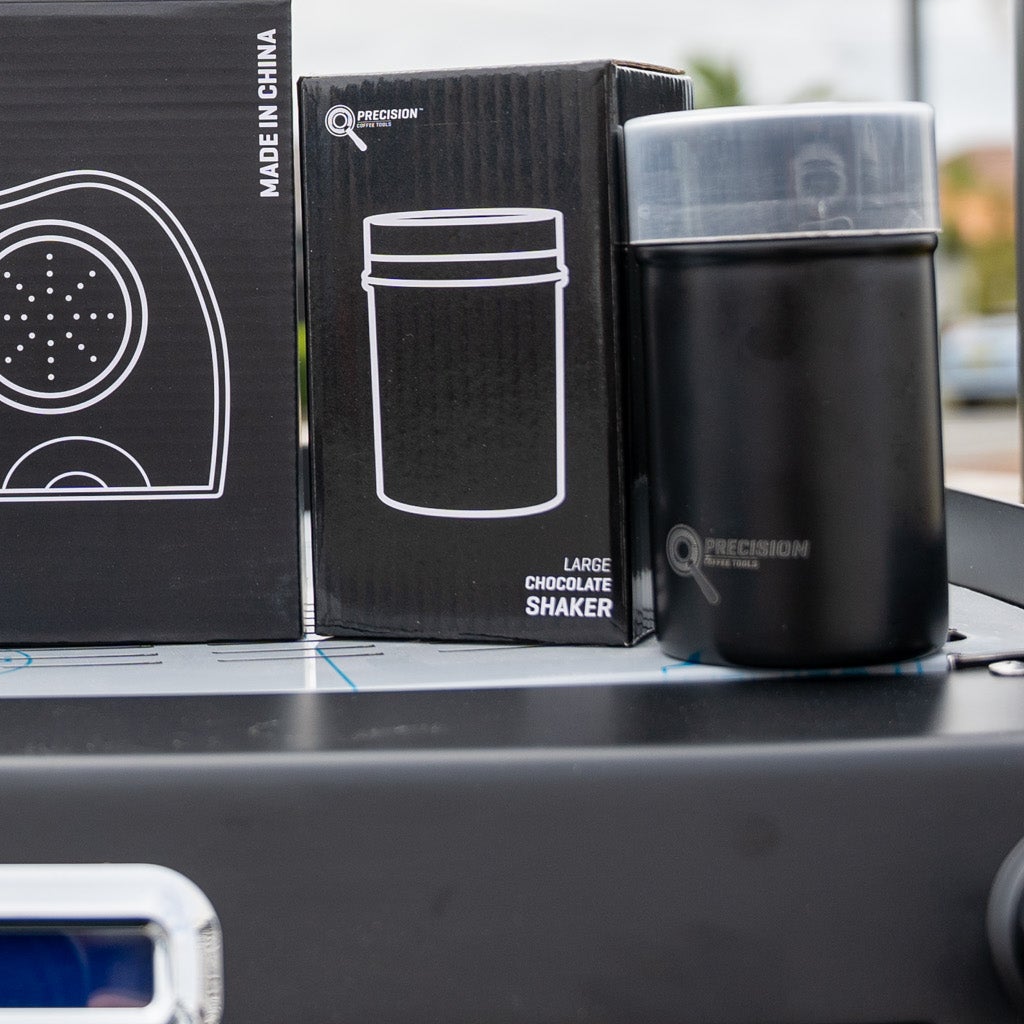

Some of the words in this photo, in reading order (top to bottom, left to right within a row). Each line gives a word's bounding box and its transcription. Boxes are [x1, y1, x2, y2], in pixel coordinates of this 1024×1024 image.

[256, 28, 278, 99] CHINA
[258, 105, 278, 128] IN
[357, 107, 418, 121] PRECISION
[259, 133, 280, 198] MADE
[704, 538, 810, 557] PRECISION
[563, 557, 612, 572] LARGE
[733, 559, 759, 568] TOOLS
[524, 575, 612, 592] CHOCOLATE
[525, 596, 613, 617] SHAKER
